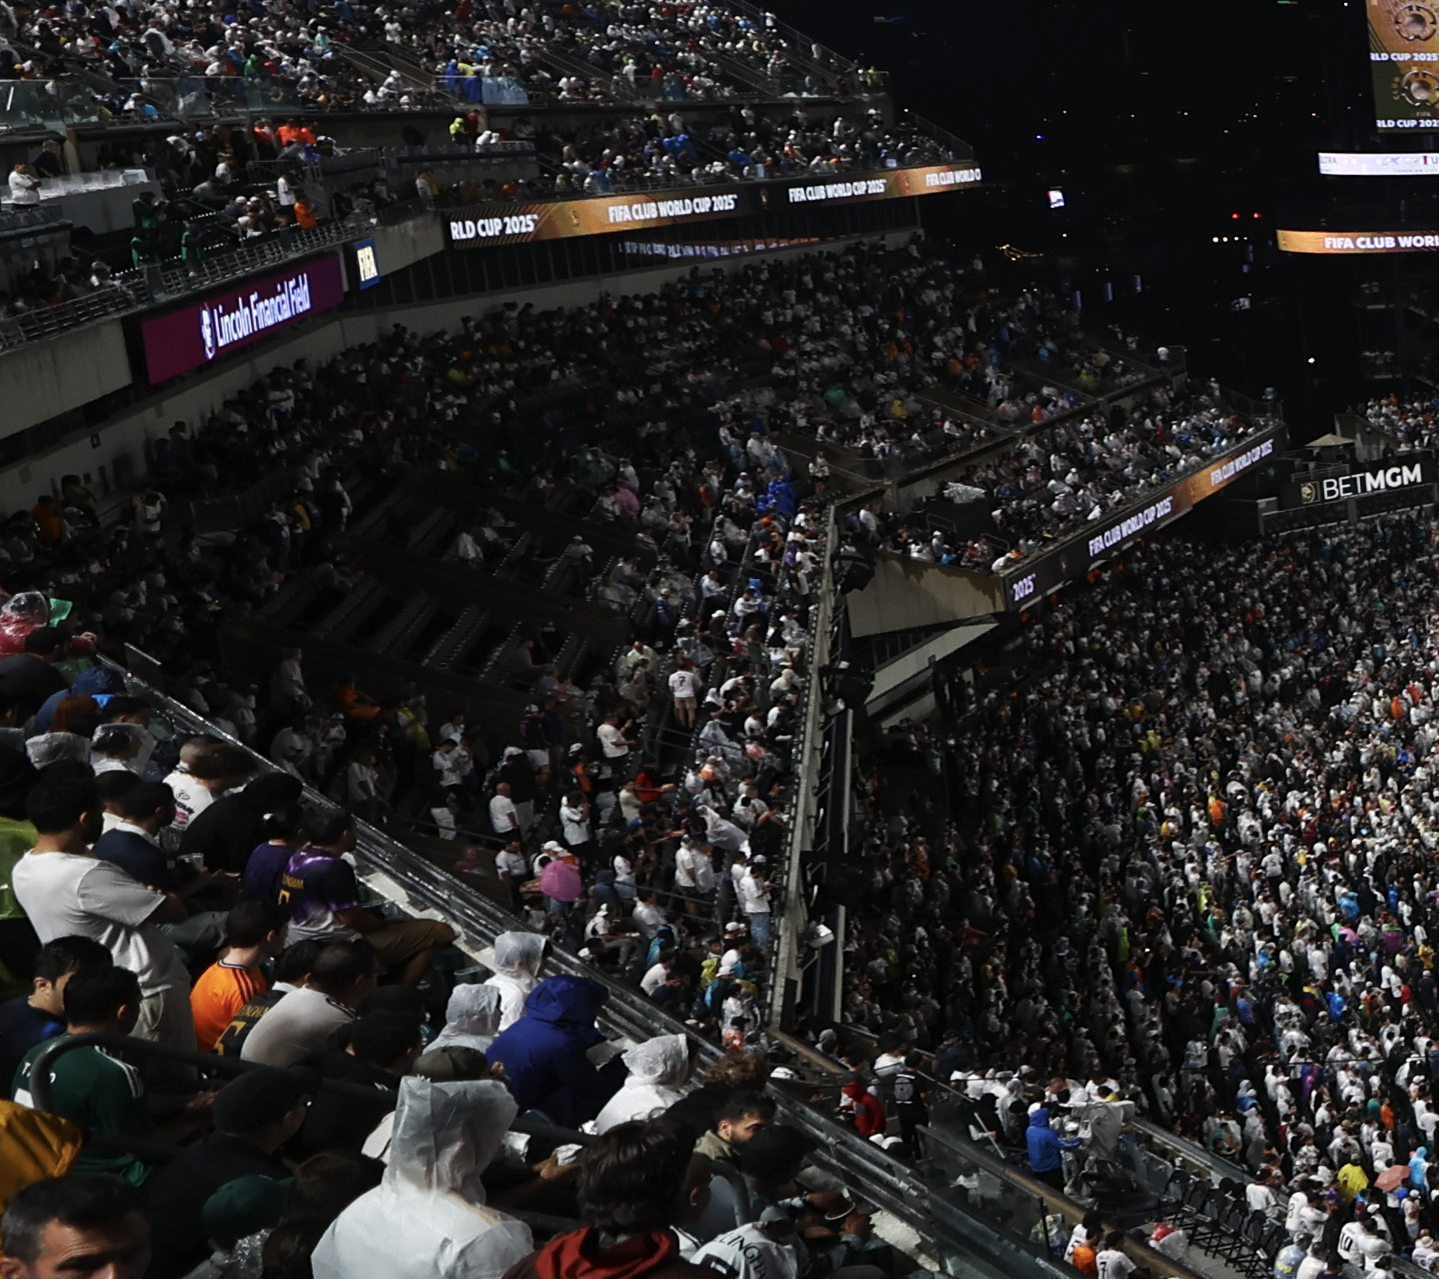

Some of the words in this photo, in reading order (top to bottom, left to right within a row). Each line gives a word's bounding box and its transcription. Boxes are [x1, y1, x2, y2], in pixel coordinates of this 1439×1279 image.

[608, 205, 632, 223] FIFA
[631, 202, 658, 220] CLUB
[657, 199, 692, 217] WORLD
[693, 196, 711, 213] CUP
[476, 217, 503, 237] CUP
[1324, 237, 1355, 249] FIFA
[1355, 236, 1396, 249] CLUB
[356, 246, 378, 282] FIFA
[213, 297, 251, 347] Lincoln
[250, 282, 290, 333] Financial
[289, 273, 312, 319] Field
[1323, 463, 1422, 501] BETMGM
[1340, 1234, 1353, 1251] 10
